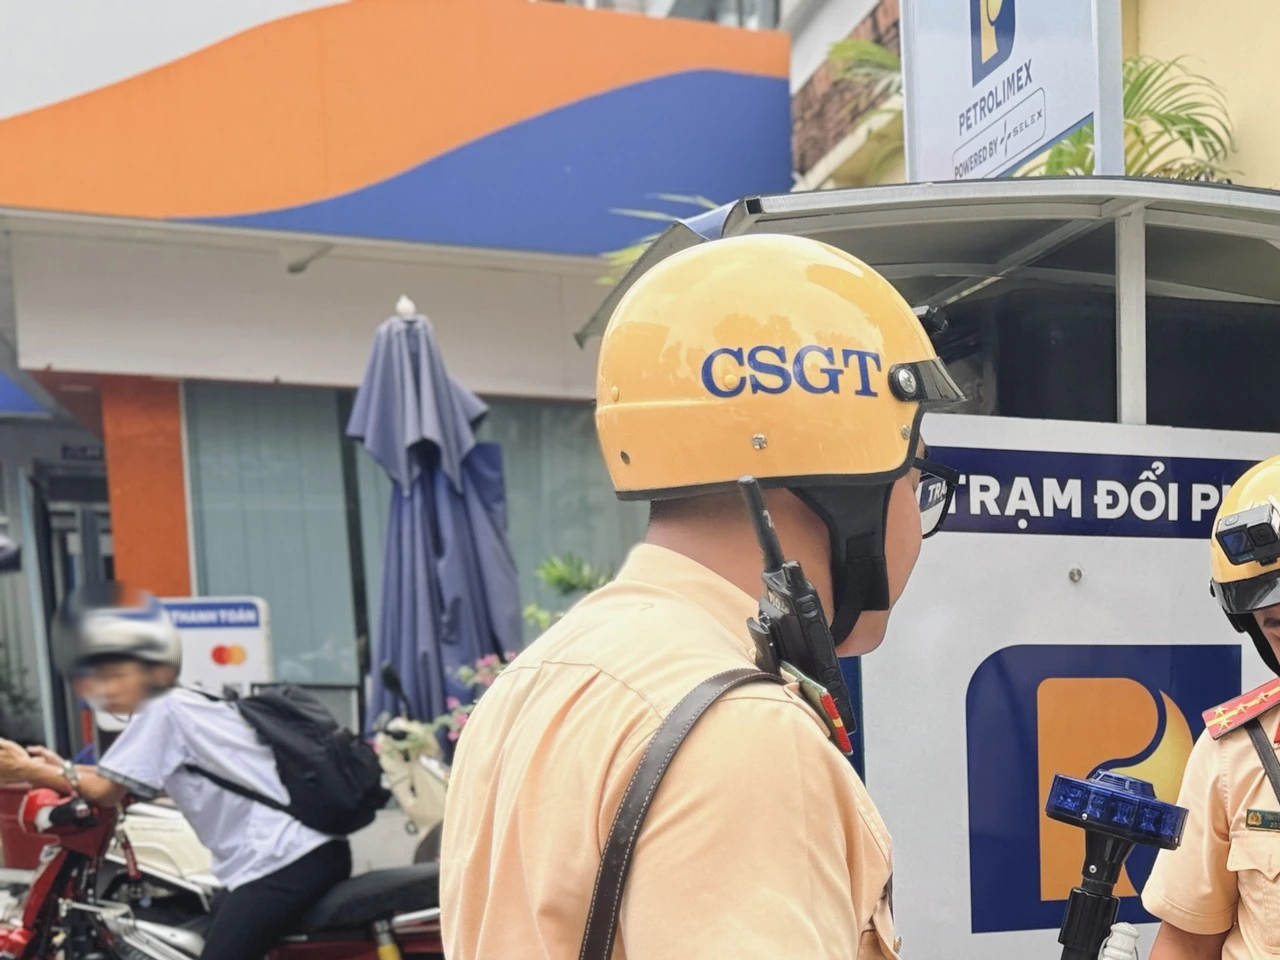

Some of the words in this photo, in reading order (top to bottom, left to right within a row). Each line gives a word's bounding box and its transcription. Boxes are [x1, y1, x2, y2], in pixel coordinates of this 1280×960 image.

[959, 58, 1032, 136] PETROLIMEX
[954, 146, 987, 180] POWERED
[988, 136, 998, 158] BY
[1013, 108, 1043, 138] SELEX
[701, 345, 881, 398] CSGT
[1094, 460, 1178, 521] ĐỔI
